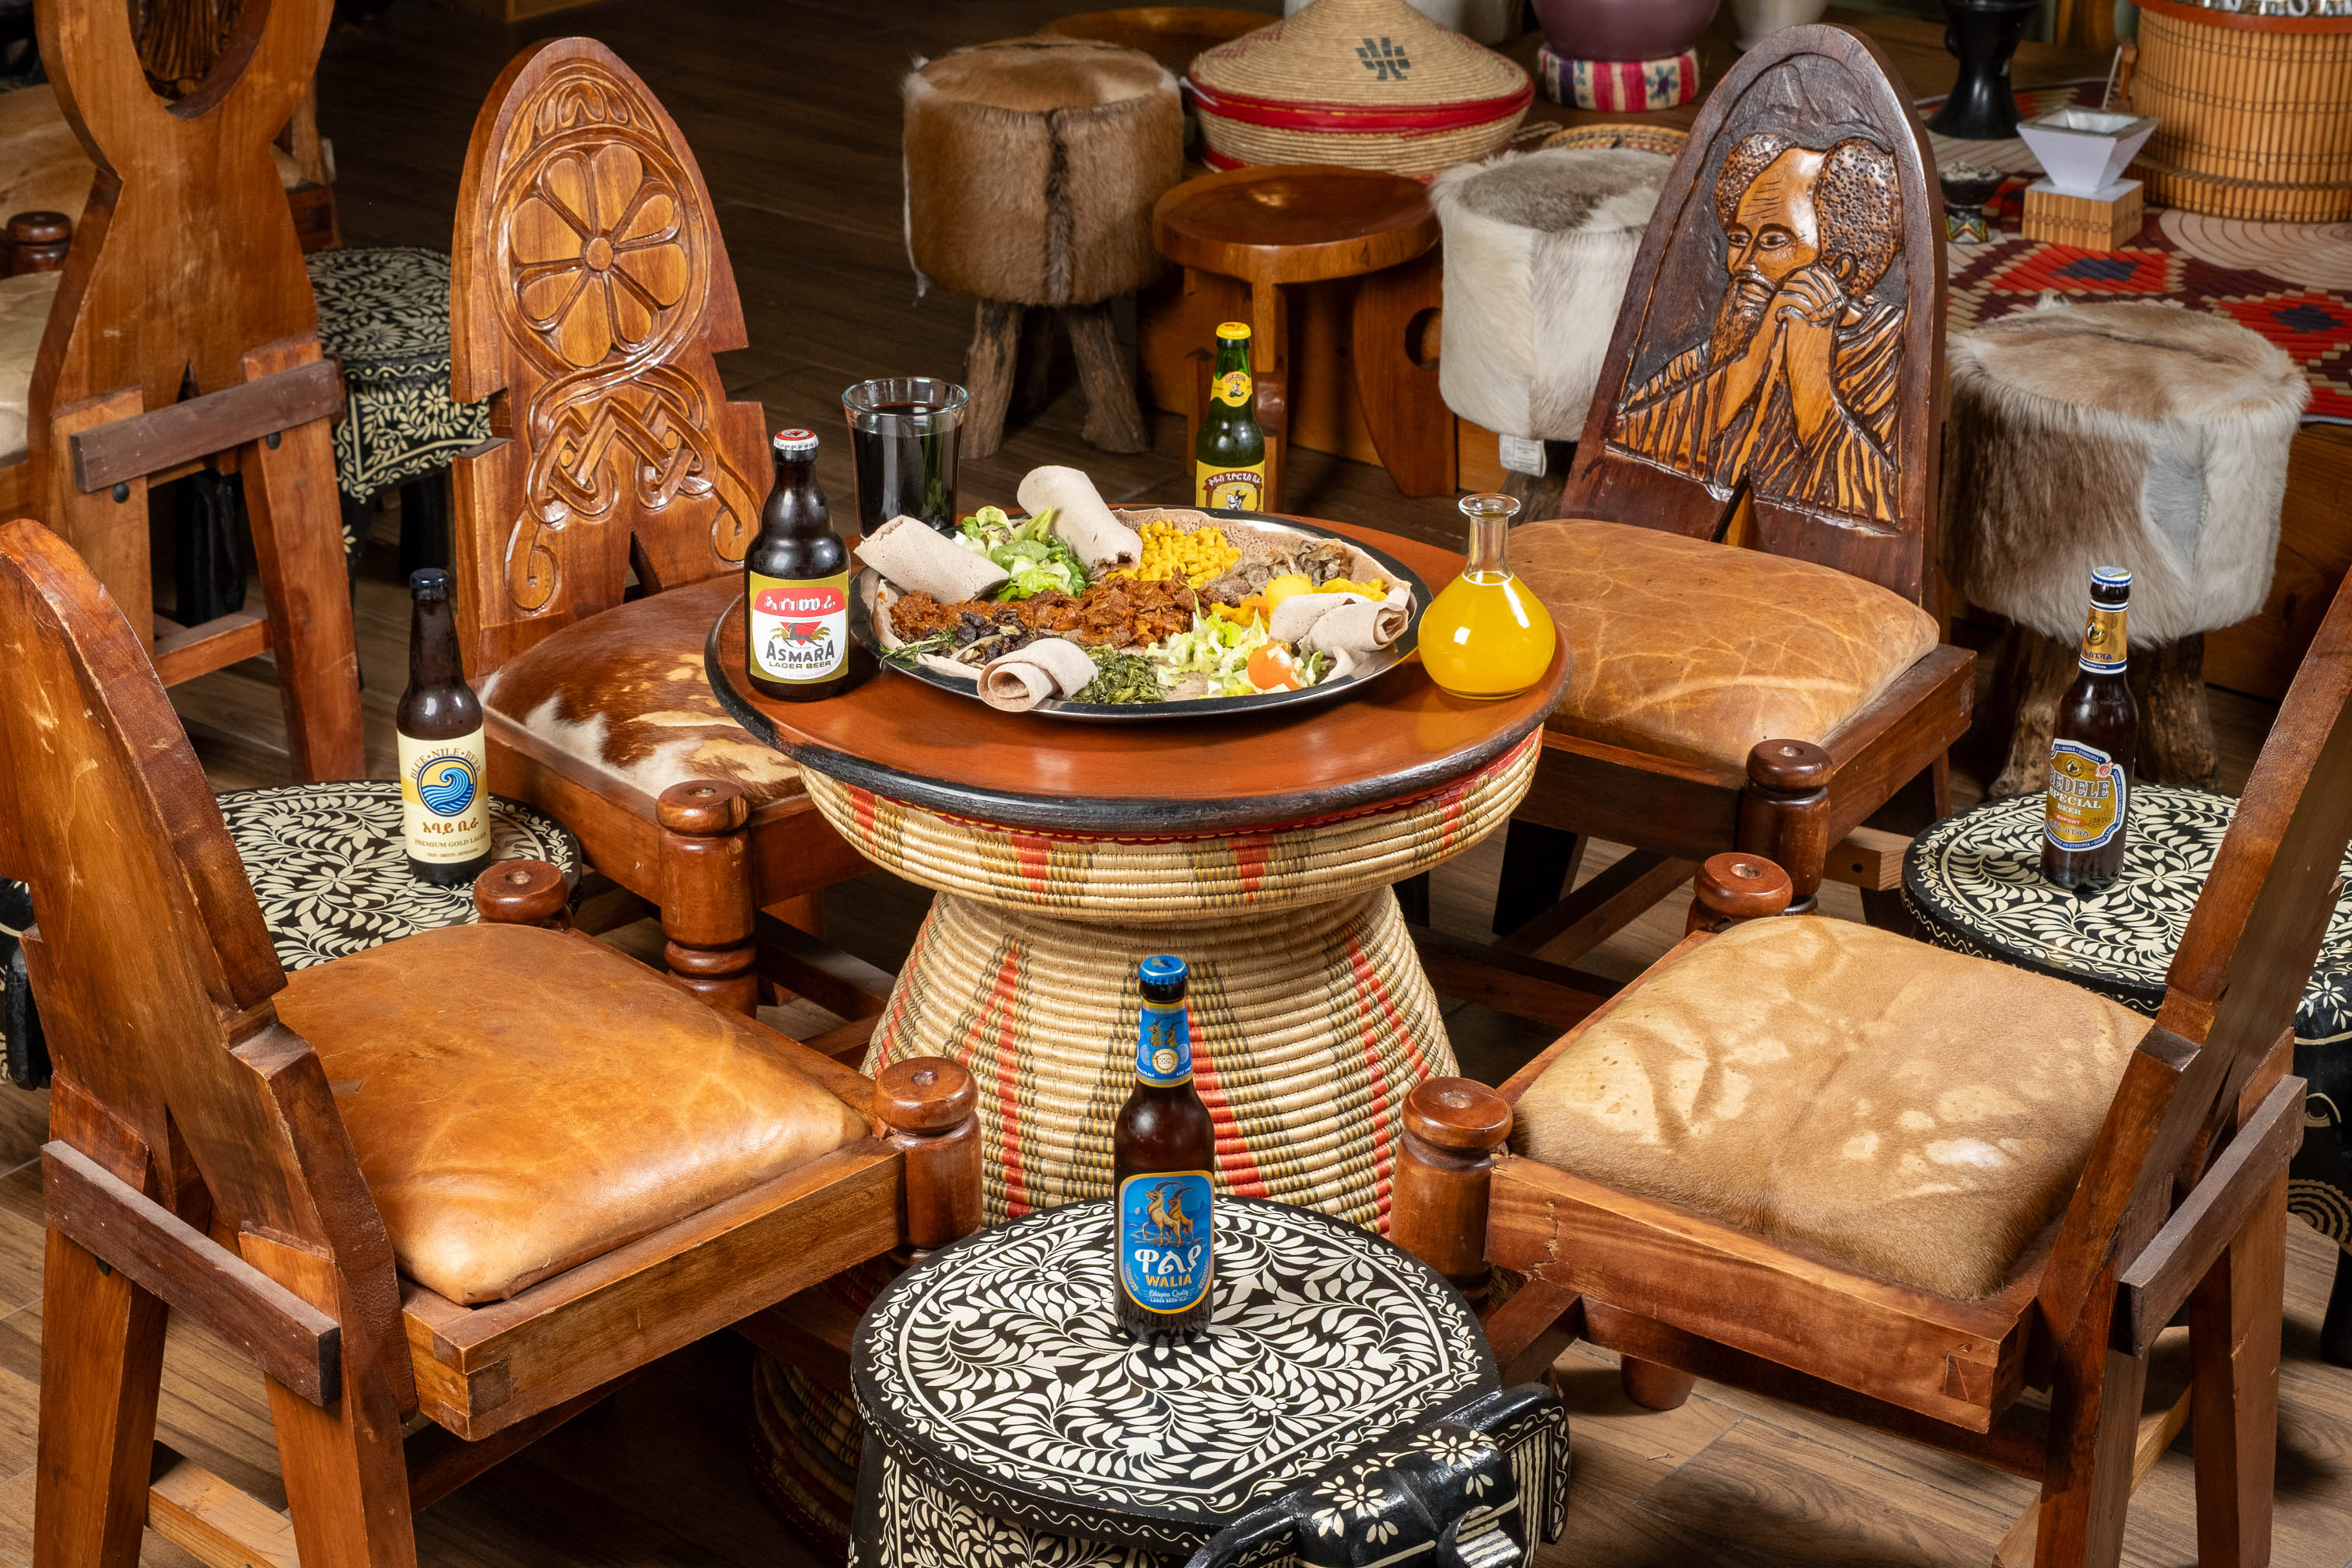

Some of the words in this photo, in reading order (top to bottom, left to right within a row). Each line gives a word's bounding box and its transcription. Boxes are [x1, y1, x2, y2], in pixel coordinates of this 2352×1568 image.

[766, 639, 835, 663] ASMARA
[806, 660, 831, 669] BEER
[411, 754, 425, 781] BLUE
[431, 747, 460, 759] NILE
[466, 751, 481, 774] BEER
[2049, 786, 2102, 809] SPECIAL
[2057, 803, 2081, 816] BEER
[422, 821, 453, 835] አባይ
[457, 817, 479, 832] ቢራ
[2056, 814, 2081, 825] EXPORT
[414, 838, 446, 848] PREMIUM
[448, 836, 469, 847] GOLD
[470, 832, 486, 844] LAGER
[1134, 1244, 1202, 1276] ዋልያ
[1145, 1273, 1192, 1287] WALIA
[1149, 1289, 1171, 1300] Ethiopian
[1171, 1289, 1189, 1299] Quality
